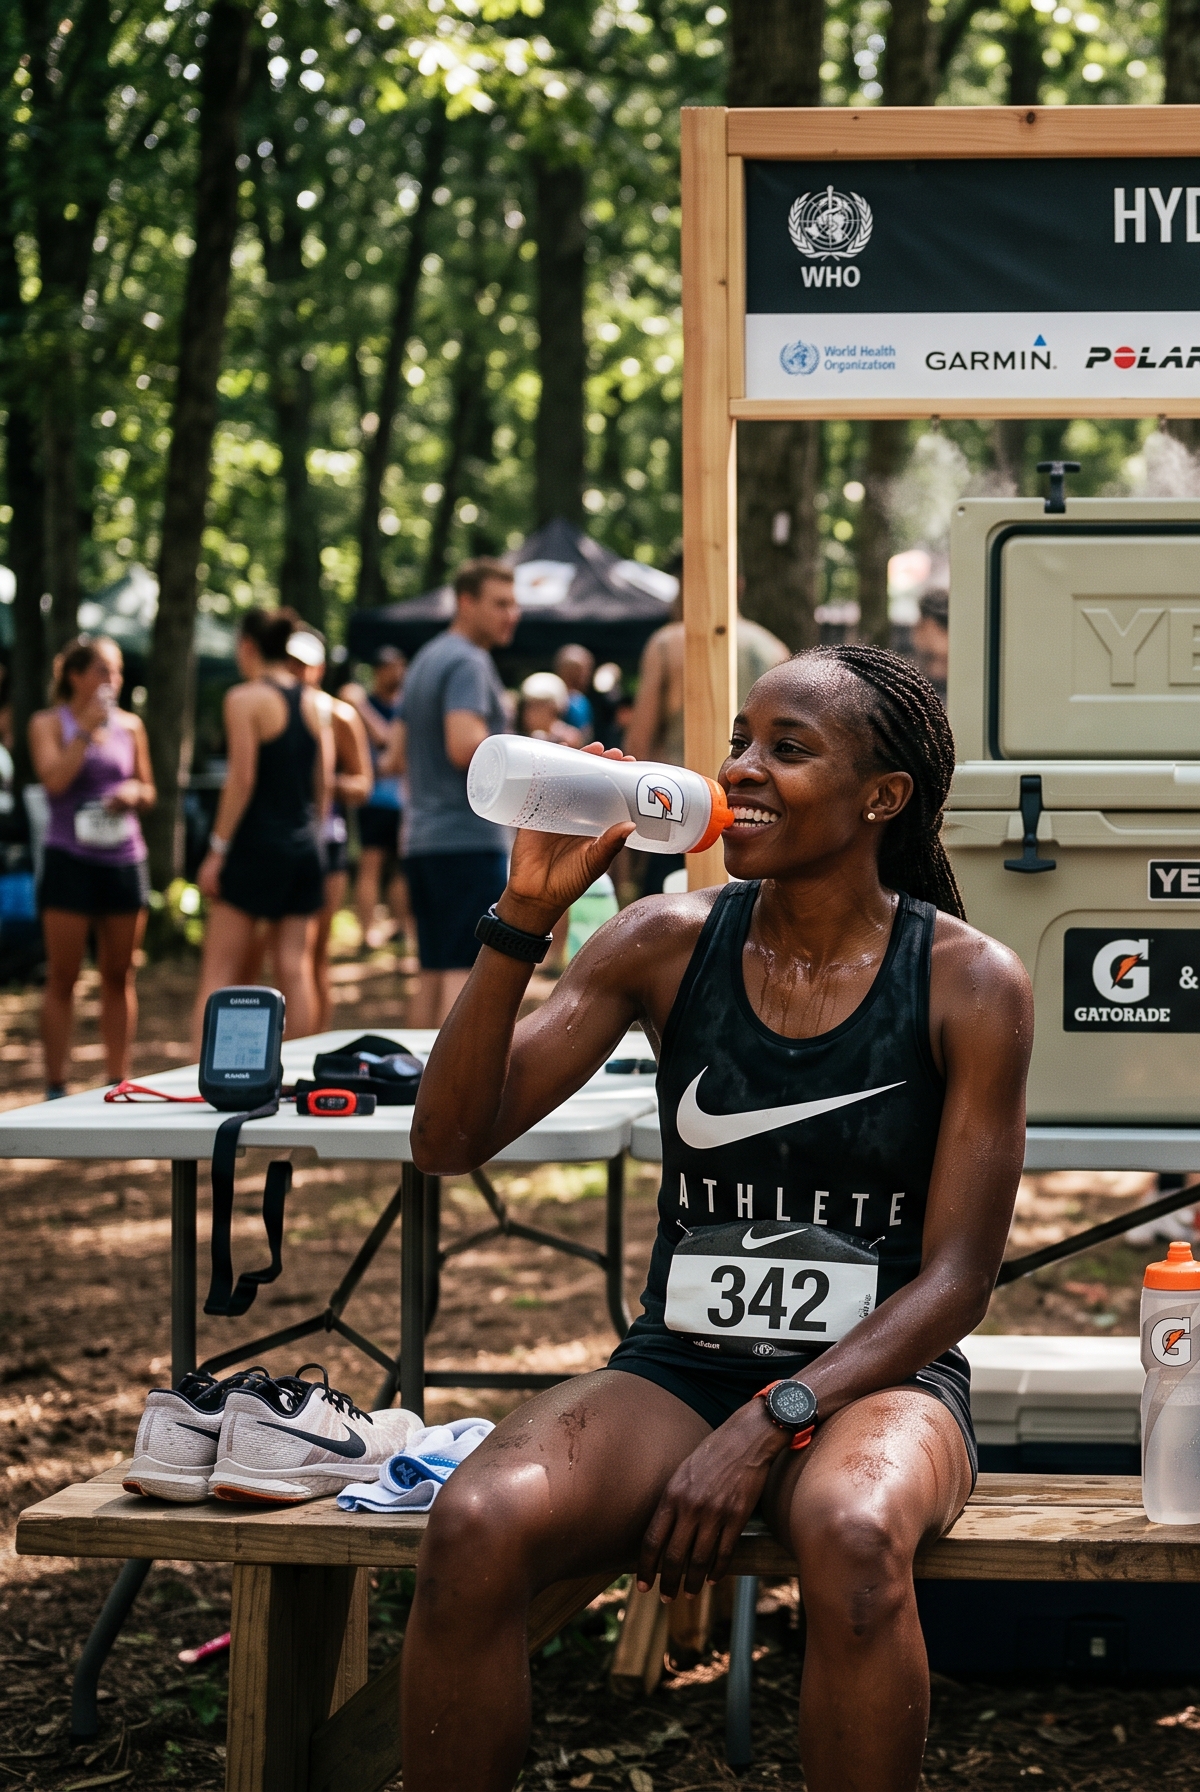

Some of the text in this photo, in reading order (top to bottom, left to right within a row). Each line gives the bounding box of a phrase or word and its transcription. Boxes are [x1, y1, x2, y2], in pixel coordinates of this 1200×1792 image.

[800, 265, 861, 288] WHO
[824, 345, 896, 357] World Health
[925, 351, 1051, 371] GARMIN
[824, 359, 896, 374] Organization
[1179, 965, 1199, 990] &
[1074, 1007, 1171, 1023] GATORADE
[678, 1172, 906, 1227] ATHLETE
[706, 1264, 830, 1333] 342
